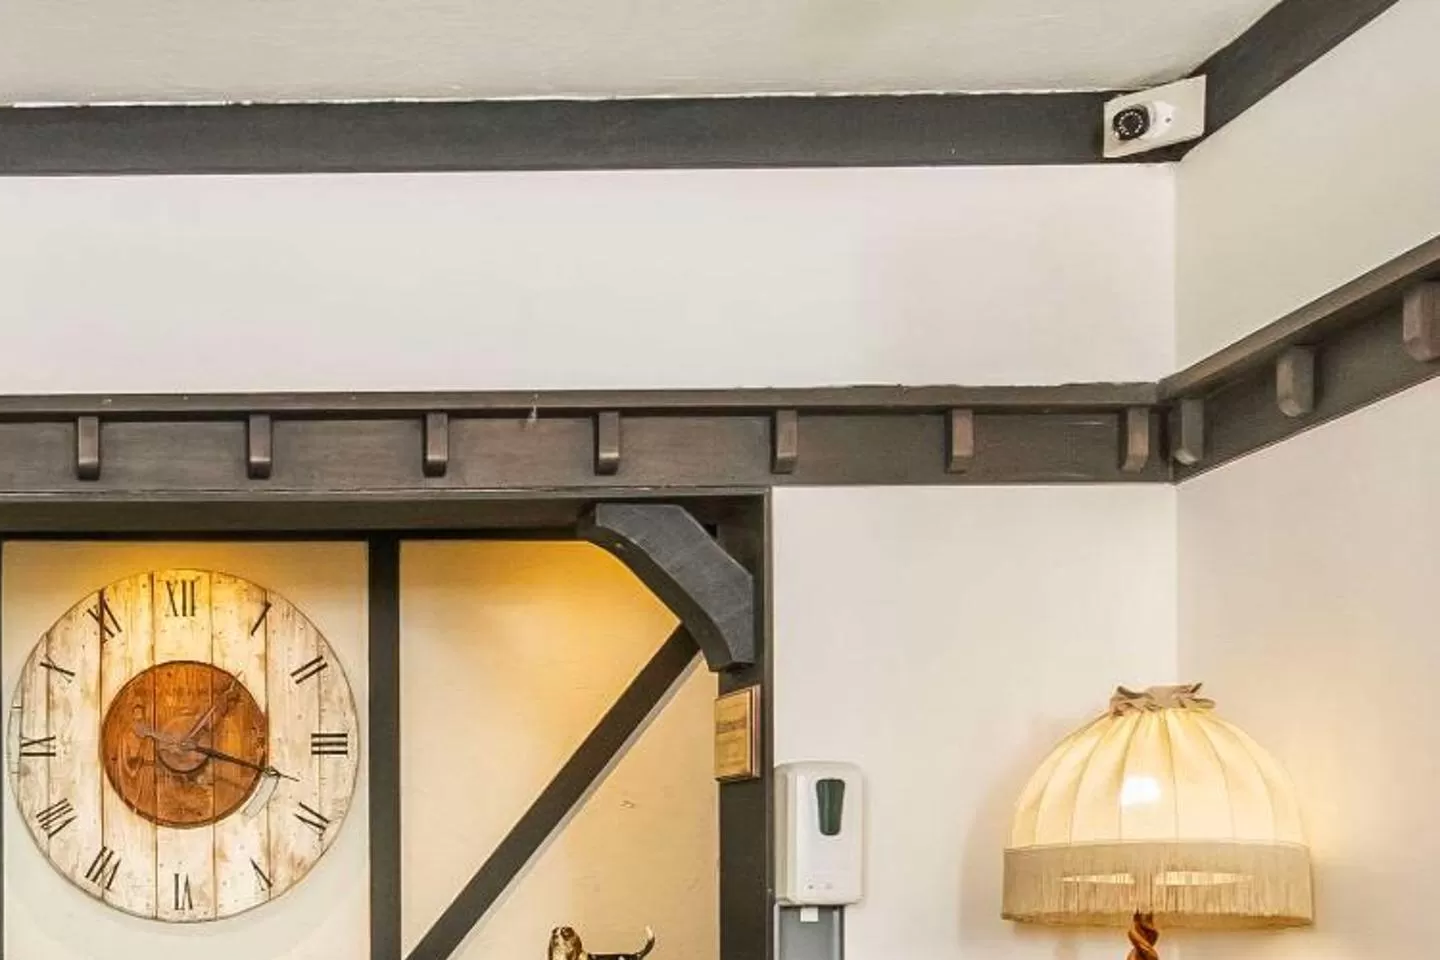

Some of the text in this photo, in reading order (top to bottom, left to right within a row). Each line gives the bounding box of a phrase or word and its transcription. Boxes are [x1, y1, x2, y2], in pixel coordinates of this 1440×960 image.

[165, 579, 196, 618] XII
[290, 655, 328, 685] II
[310, 732, 348, 756] III
